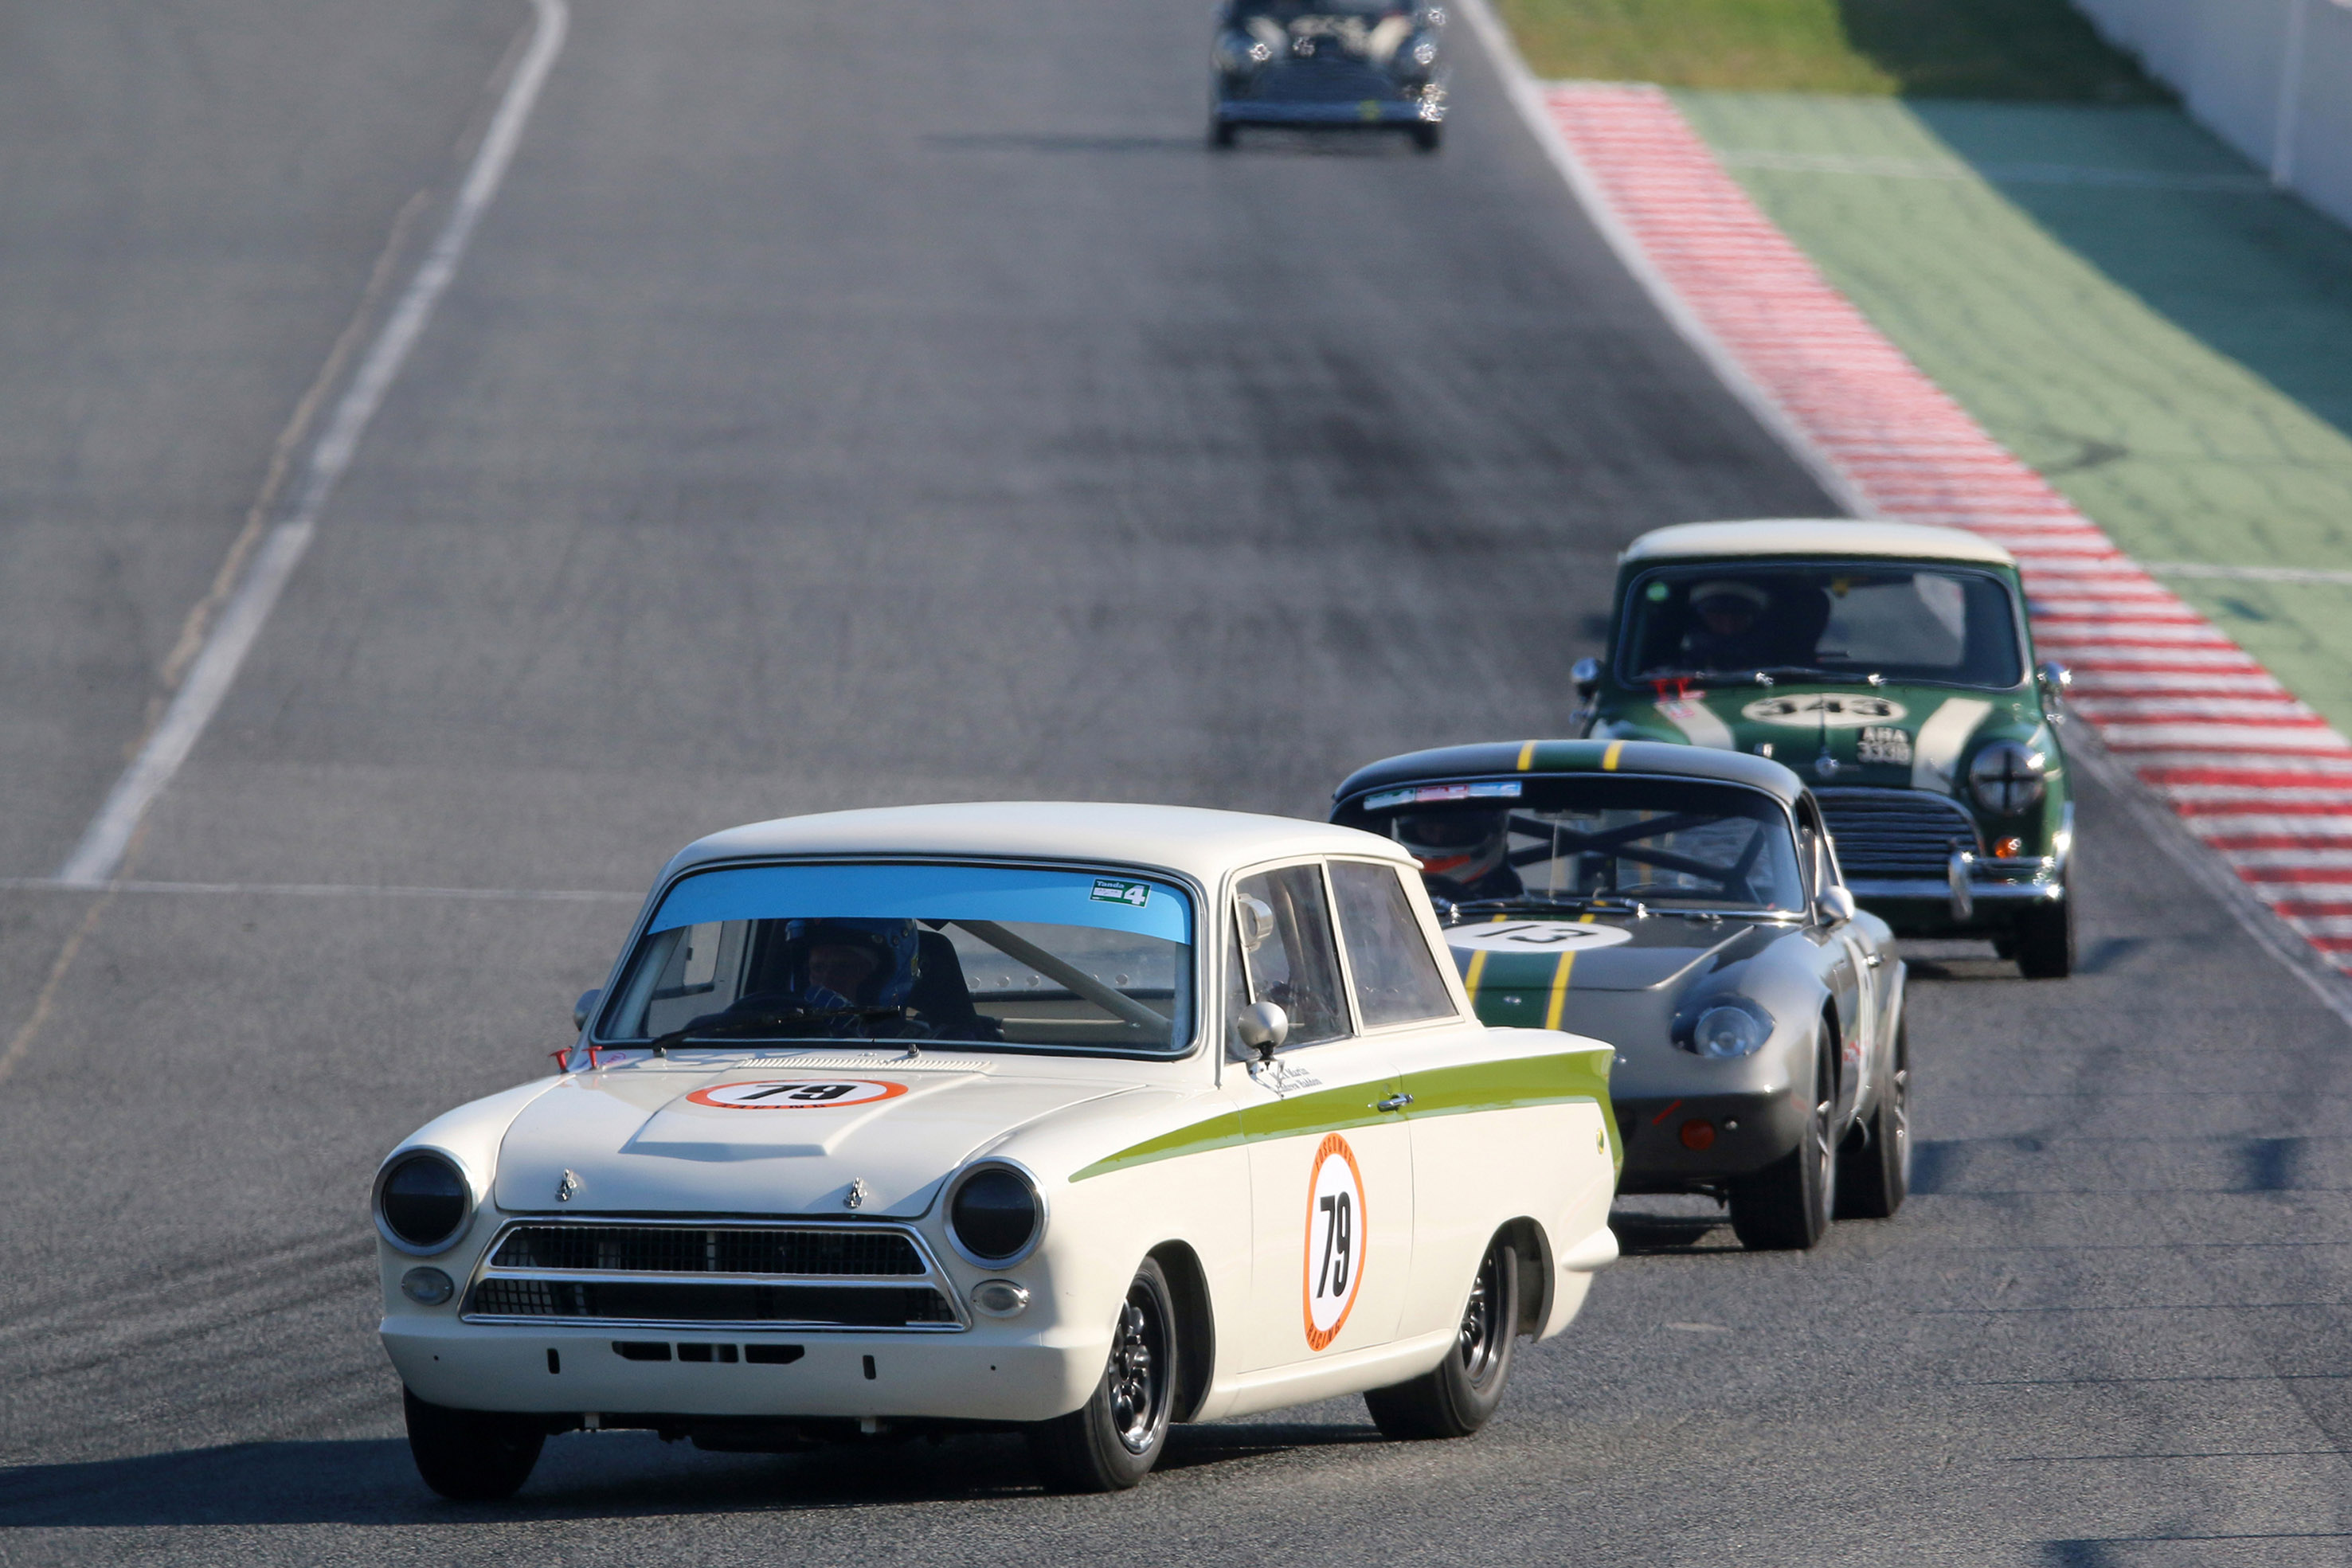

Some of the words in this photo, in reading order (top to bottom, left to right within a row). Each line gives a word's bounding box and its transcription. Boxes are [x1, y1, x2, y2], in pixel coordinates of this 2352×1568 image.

[1755, 698, 1892, 717] 343
[1096, 880, 1125, 889] Tanda
[1123, 885, 1146, 905] 4
[1474, 925, 1599, 944] 13
[734, 1084, 859, 1101] 79
[1314, 1135, 1352, 1172] FOSCOMBE
[1316, 1191, 1352, 1298] 79
[1305, 1318, 1341, 1350] RACING
